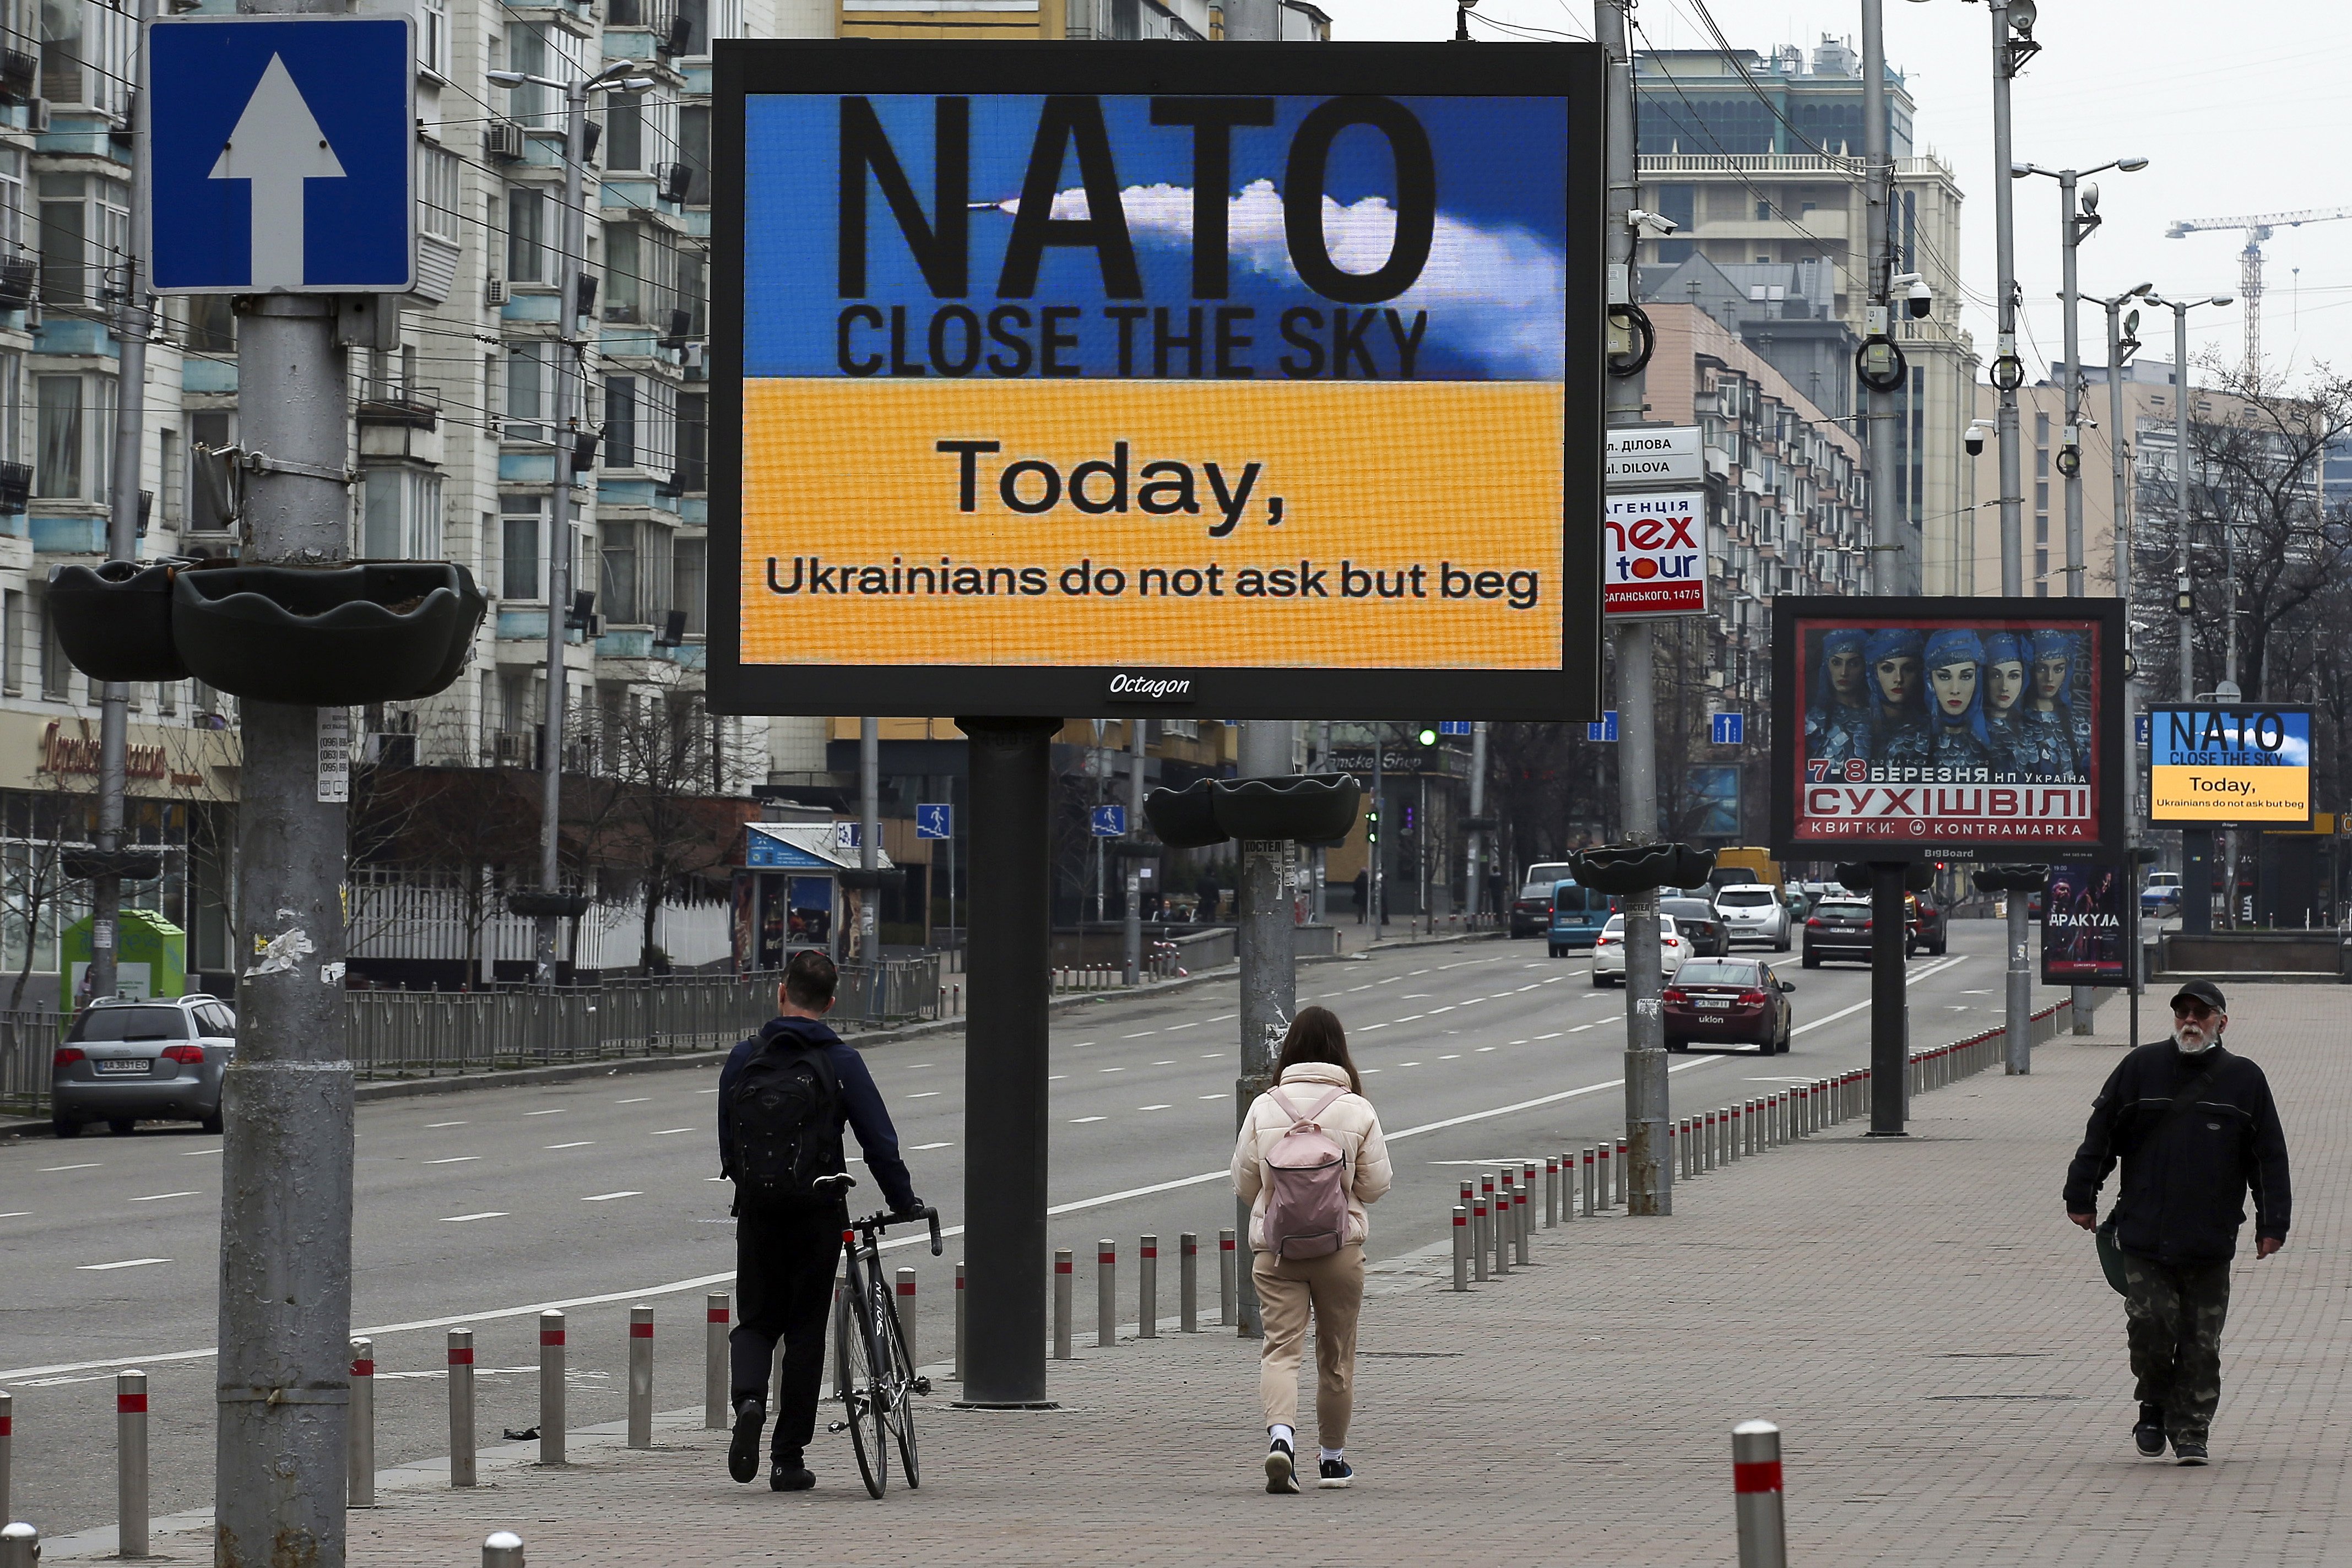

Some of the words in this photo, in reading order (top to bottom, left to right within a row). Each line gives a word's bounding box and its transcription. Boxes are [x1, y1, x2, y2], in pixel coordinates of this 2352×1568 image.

[837, 94, 1435, 303] NATO
[837, 305, 1080, 378] CLOSE
[1105, 307, 1254, 379] THE
[1279, 306, 1427, 380] SKY
[1622, 440, 1672, 452] ДІЛОВА
[1623, 462, 1670, 474] DILOVA
[936, 441, 1284, 537] Today,
[1616, 555, 1698, 581] tour
[767, 557, 1048, 595] Ukrainians
[1059, 558, 1125, 596] do
[1139, 563, 1224, 596] not
[1235, 560, 1328, 598] ask
[1341, 560, 1427, 598] but
[1441, 562, 1538, 610] beg
[1673, 589, 1700, 600] 147/5
[1109, 673, 1191, 698] Octagon
[2170, 713, 2284, 752] NATO
[2170, 752, 2217, 765] CLOSE
[2221, 752, 2250, 766] THE
[2254, 752, 2283, 766] SKY
[1808, 758, 1867, 782] 7-8
[1871, 767, 1988, 782] БЕРЕЗНЯ
[1995, 772, 2016, 783] НП
[2024, 771, 2086, 783] УКРАЇНА
[2189, 777, 2256, 796] Today,
[1808, 788, 2086, 816] СУХІШВІЛІ
[2156, 799, 2210, 807] Ukrainians
[2213, 799, 2226, 807] do
[2246, 799, 2264, 807] ask
[2285, 800, 2304, 810] beg
[1812, 822, 1894, 834] КВИТКИ:
[1934, 823, 2082, 835] KONTRAMARKA
[1245, 841, 1281, 853] ХОСТЕЛ
[1925, 849, 1974, 858] BigBoard
[2049, 914, 2120, 926] ДРАКУЛА
[1699, 1015, 1724, 1023] uklon
